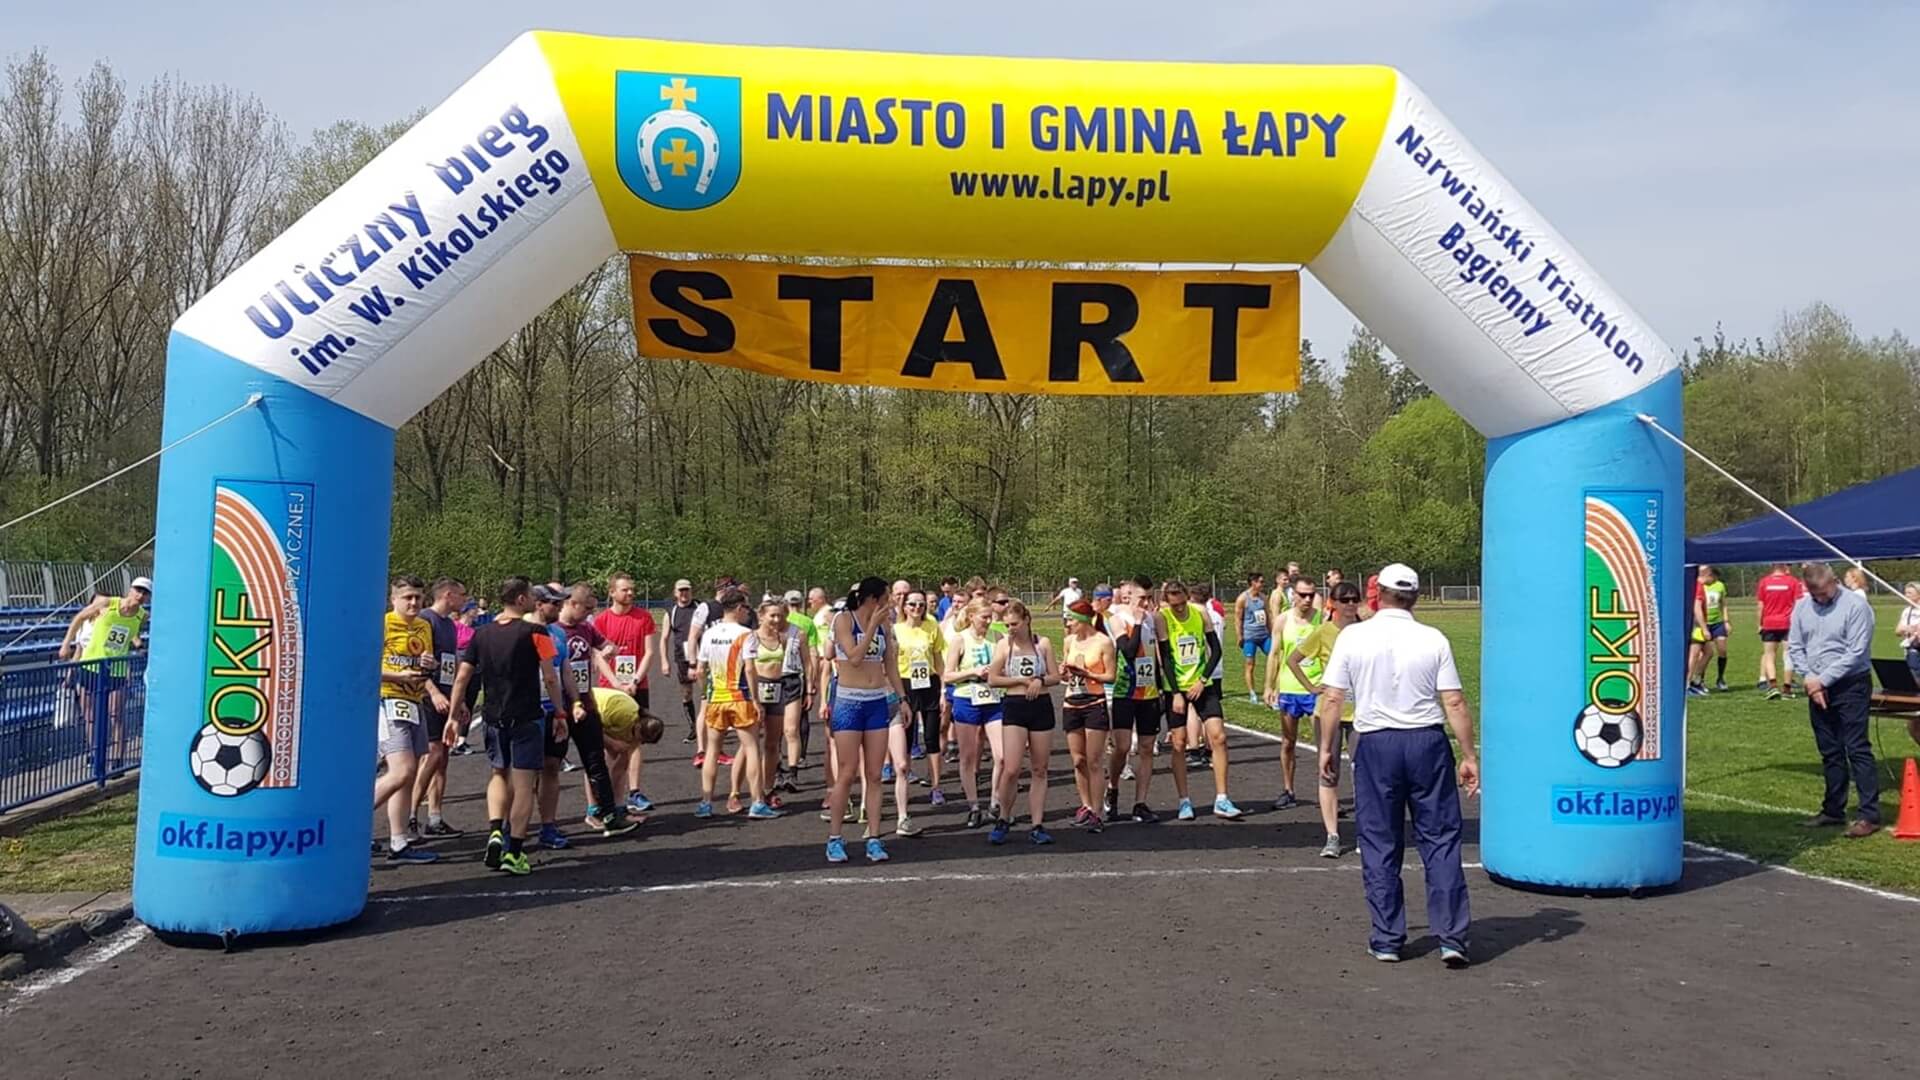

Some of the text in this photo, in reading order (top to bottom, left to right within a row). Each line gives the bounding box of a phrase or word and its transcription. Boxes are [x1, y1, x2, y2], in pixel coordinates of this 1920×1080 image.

[766, 93, 1346, 157] MIASTO I GMINA ŁAPY
[950, 167, 1170, 208] www.lapy.pl
[291, 333, 357, 376] im.
[397, 149, 570, 290] Kikolskiego
[1395, 125, 1644, 374] Narwiański Triathlon
[1438, 222, 1552, 337] Bagienny
[648, 268, 1271, 383] START
[108, 631, 126, 645] 33
[280, 598, 299, 682] KULTURY
[1180, 642, 1195, 656] 77
[1590, 586, 1640, 715] OKF
[209, 589, 274, 736] OKF
[442, 662, 454, 675] 45
[572, 669, 588, 682] 35
[617, 663, 634, 675] 43
[912, 667, 928, 680] 48
[1020, 657, 1034, 676] 49
[1138, 664, 1152, 677] 42
[394, 700, 410, 719] 50
[1557, 786, 1680, 821] okf.lapy.pl
[162, 818, 325, 858] okf.lapy.pl
